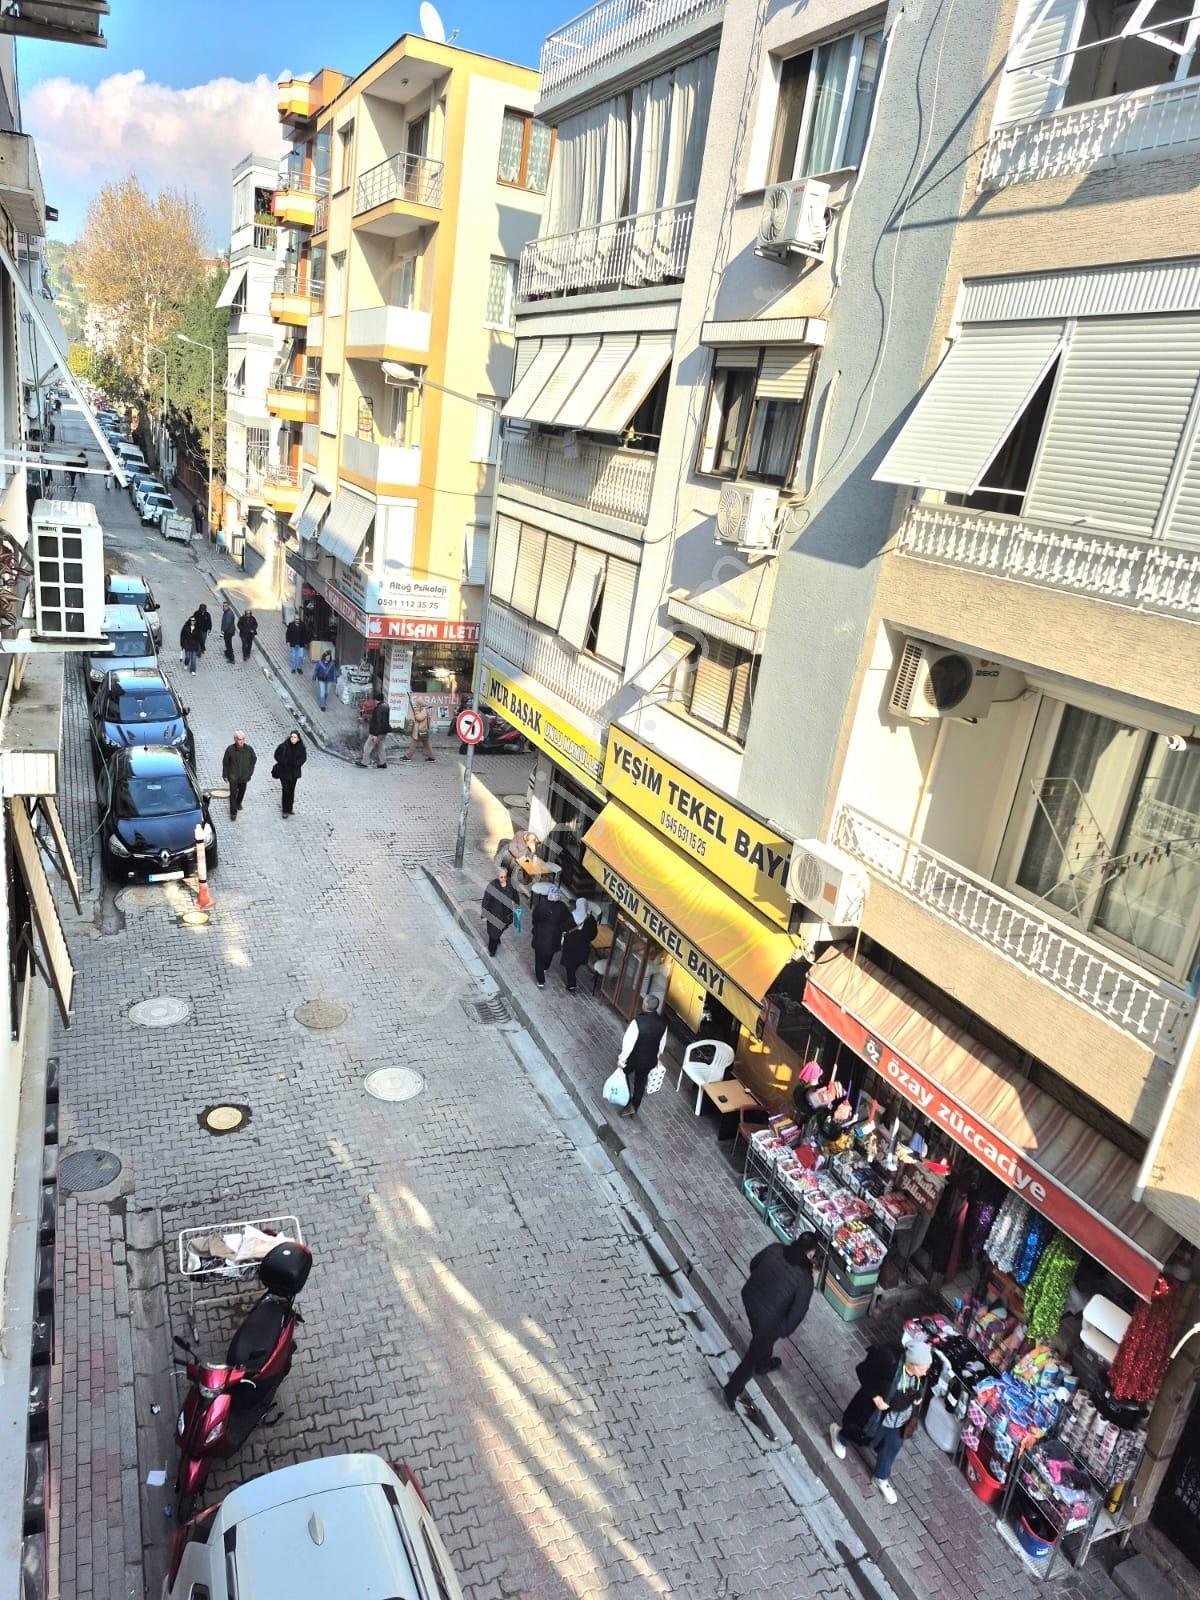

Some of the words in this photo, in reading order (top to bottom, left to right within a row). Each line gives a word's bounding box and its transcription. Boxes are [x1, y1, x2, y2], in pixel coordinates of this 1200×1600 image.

[390, 582, 411, 592] Altuğ
[414, 584, 447, 595] Psikoloji
[490, 678, 509, 710] NUR
[510, 692, 542, 735] BAŞAK
[613, 742, 663, 795] YEŞİM
[668, 780, 727, 844] TEKEL
[734, 828, 791, 888] BAYİ
[660, 810, 666, 825] 0
[665, 814, 678, 834] 545
[677, 823, 689, 843] 631
[689, 832, 697, 849] 15
[697, 838, 707, 856] 25
[642, 906, 683, 959] TEKEL
[687, 950, 726, 997] BAYİ
[887, 1058, 935, 1107] özay
[937, 1102, 1047, 1202] züccaciye
